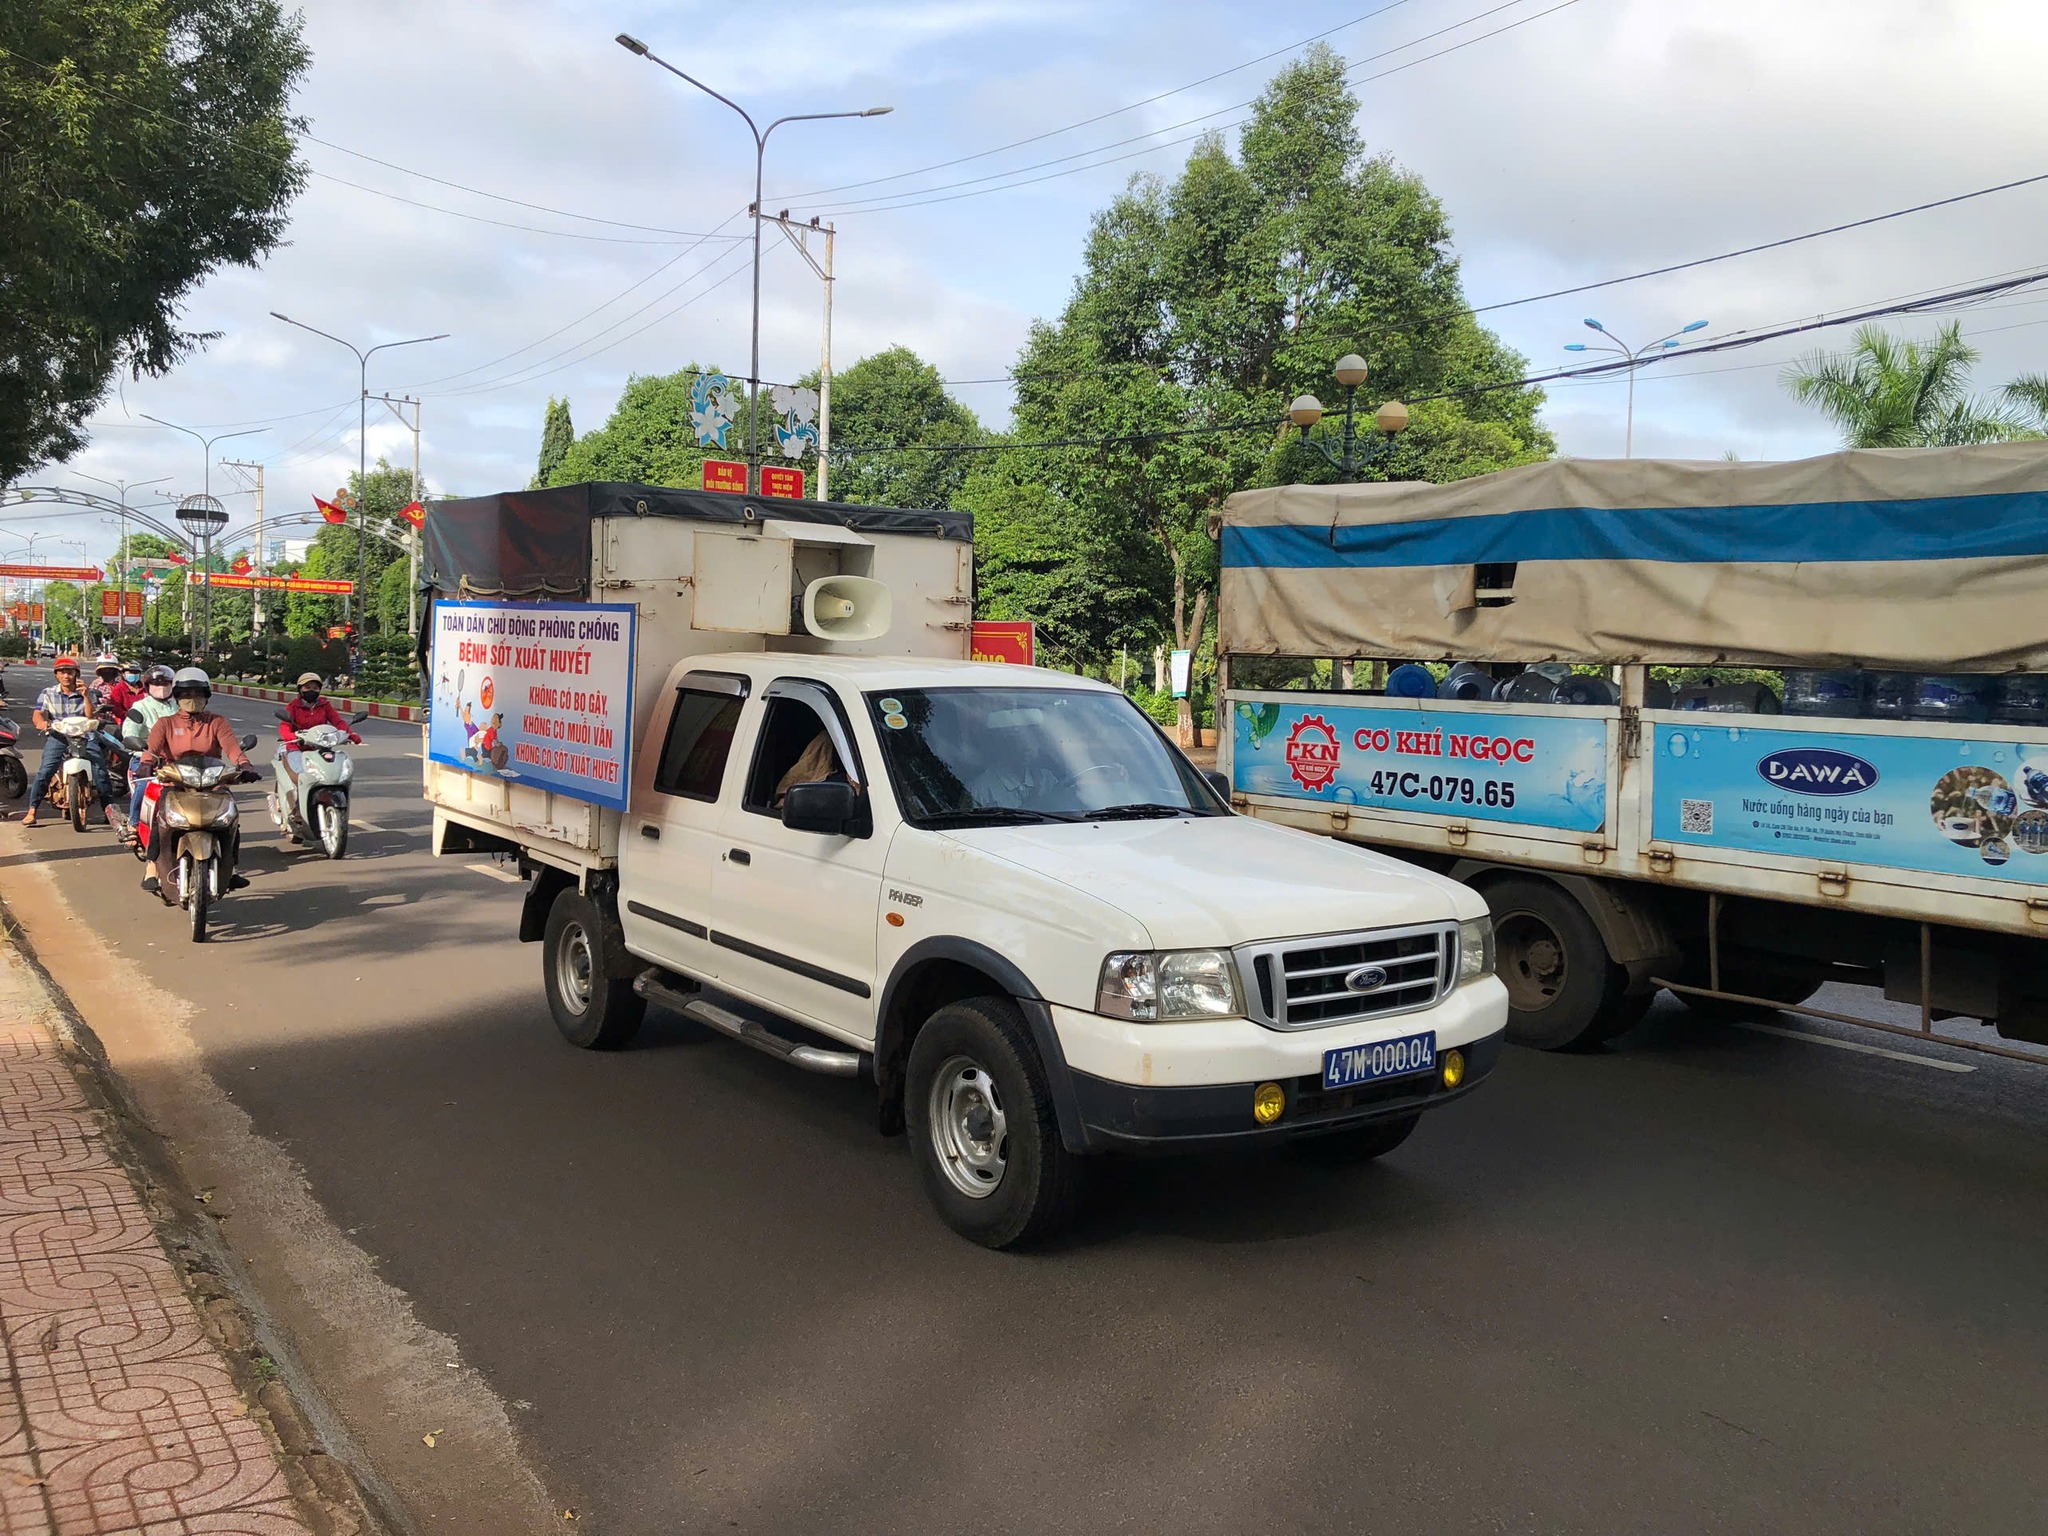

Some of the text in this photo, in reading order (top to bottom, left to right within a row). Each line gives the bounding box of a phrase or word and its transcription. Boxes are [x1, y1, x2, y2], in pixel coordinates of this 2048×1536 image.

[443, 612, 619, 642] TOÀN DÂN CHỦ ĐỘNG PHÒNG CHỐNG
[459, 638, 592, 675] BỆNH SỐT XUẤT HUYẾT
[528, 683, 609, 719] KHÔNG CÓ BỌ GẬY,
[523, 712, 613, 749] KHÔNG CÓ MUỖI VẰN
[1354, 728, 1535, 766] CƠ KHÍ NGỌC
[515, 740, 620, 784] KHÔNG CÓ SỐT XUẤT HUYẾT
[1286, 742, 1340, 762] CKN
[1370, 770, 1516, 808] 47C-079.65
[1768, 761, 1867, 787] DAWA
[1742, 798, 1894, 827] Nước uống hàng ngày của bạn
[1359, 973, 1379, 985] Ford
[1328, 1036, 1432, 1084] 47M-000.04
